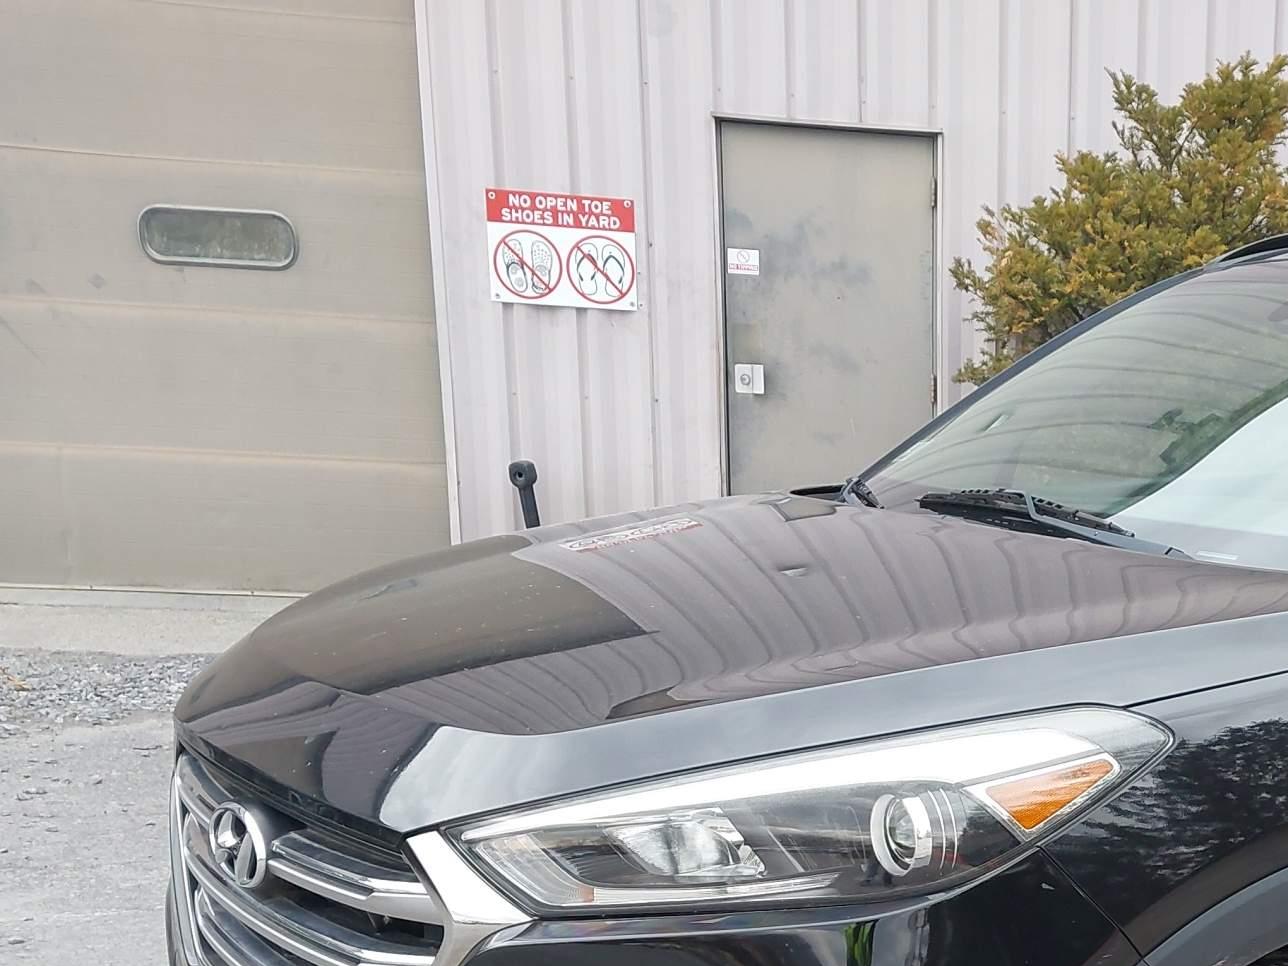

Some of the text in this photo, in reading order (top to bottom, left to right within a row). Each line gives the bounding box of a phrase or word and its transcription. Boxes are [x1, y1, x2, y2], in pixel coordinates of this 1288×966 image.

[508, 193, 612, 214] NO OPEN TOE
[501, 208, 620, 229] SHOES IN YARD
